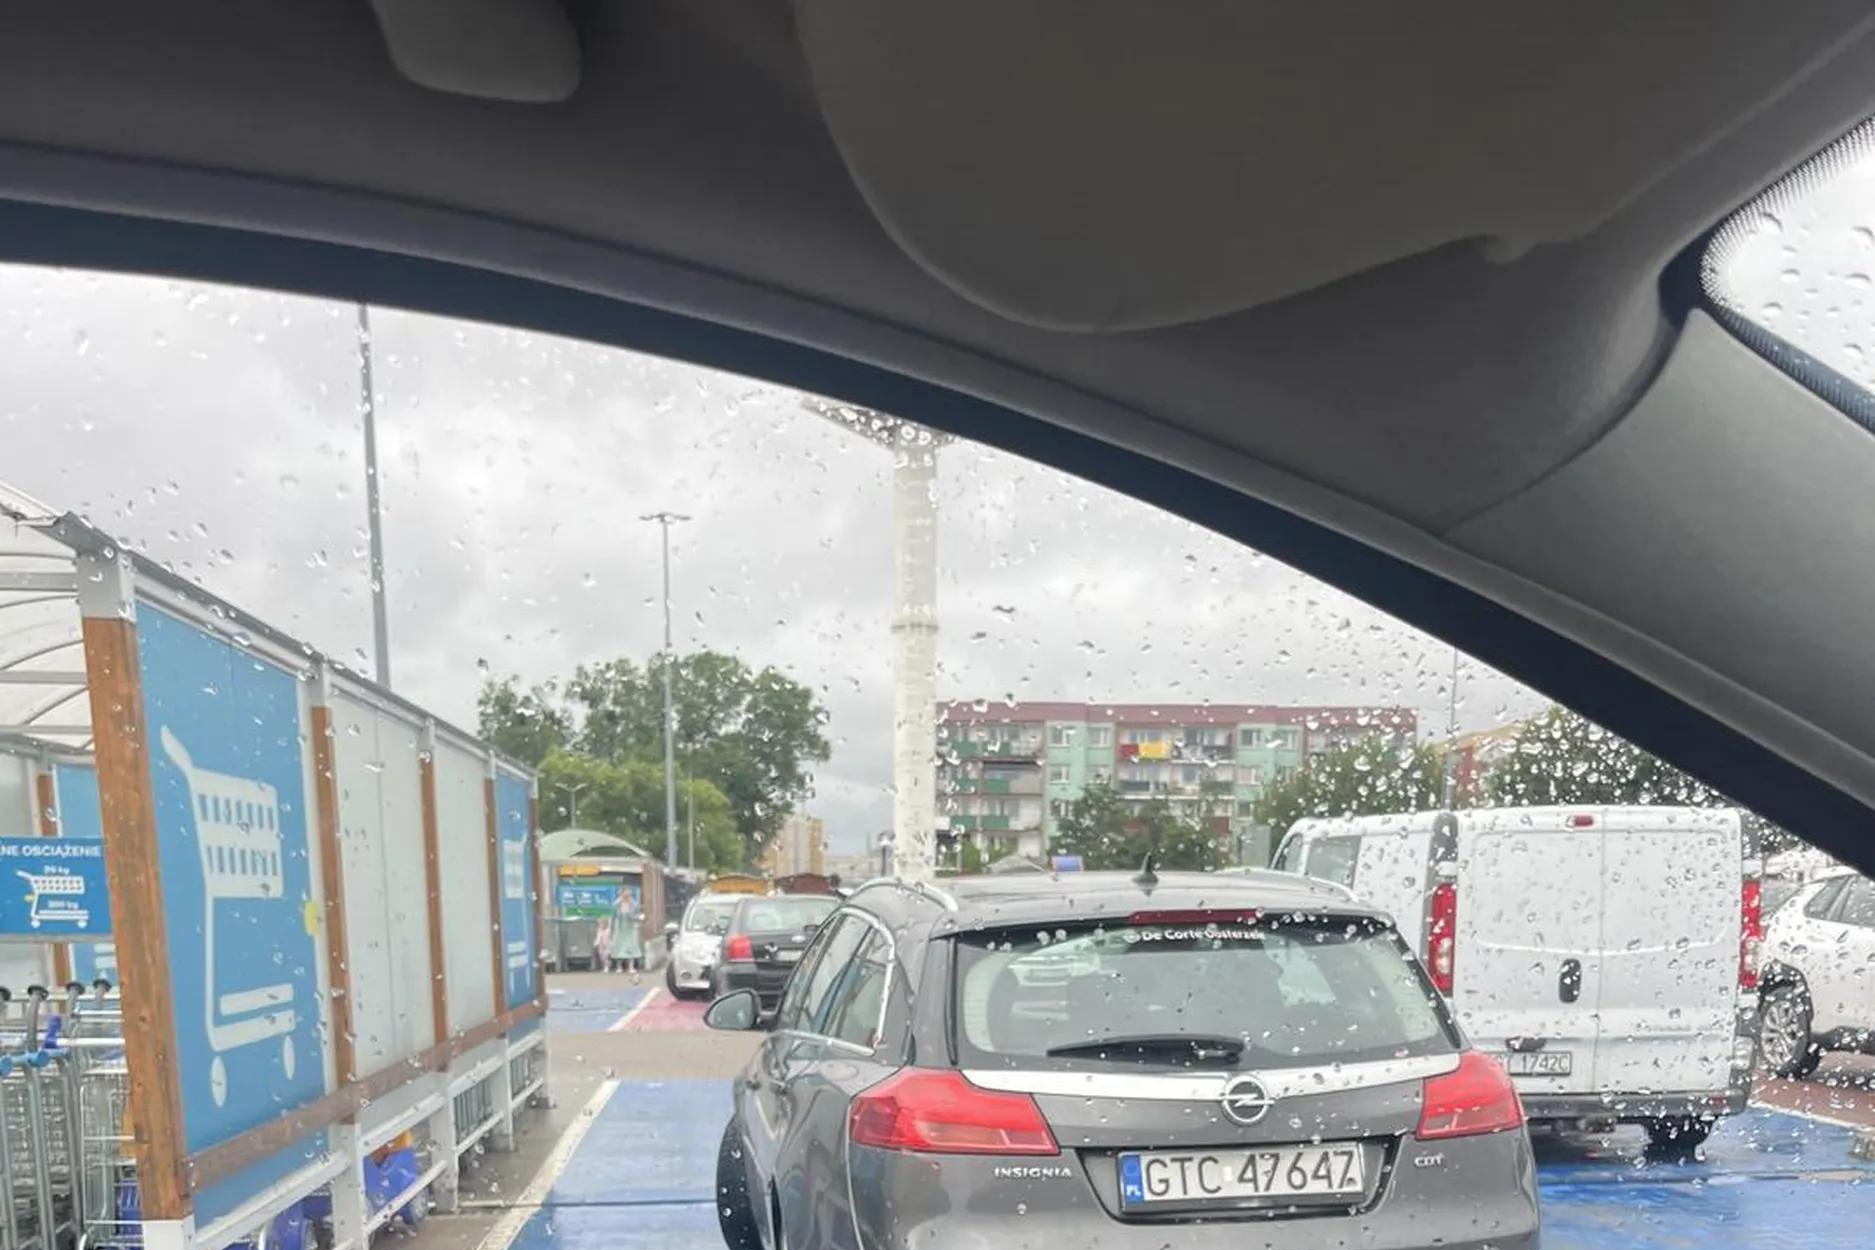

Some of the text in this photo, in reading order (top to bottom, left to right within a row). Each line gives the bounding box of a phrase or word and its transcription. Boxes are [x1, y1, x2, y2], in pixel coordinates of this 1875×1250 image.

[1141, 930, 1162, 941] De
[1164, 929, 1202, 940] Corte
[993, 1166, 1072, 1178] INSIGNIA
[1145, 1150, 1355, 1197] GTC 47647
[1126, 1186, 1141, 1196] PL
